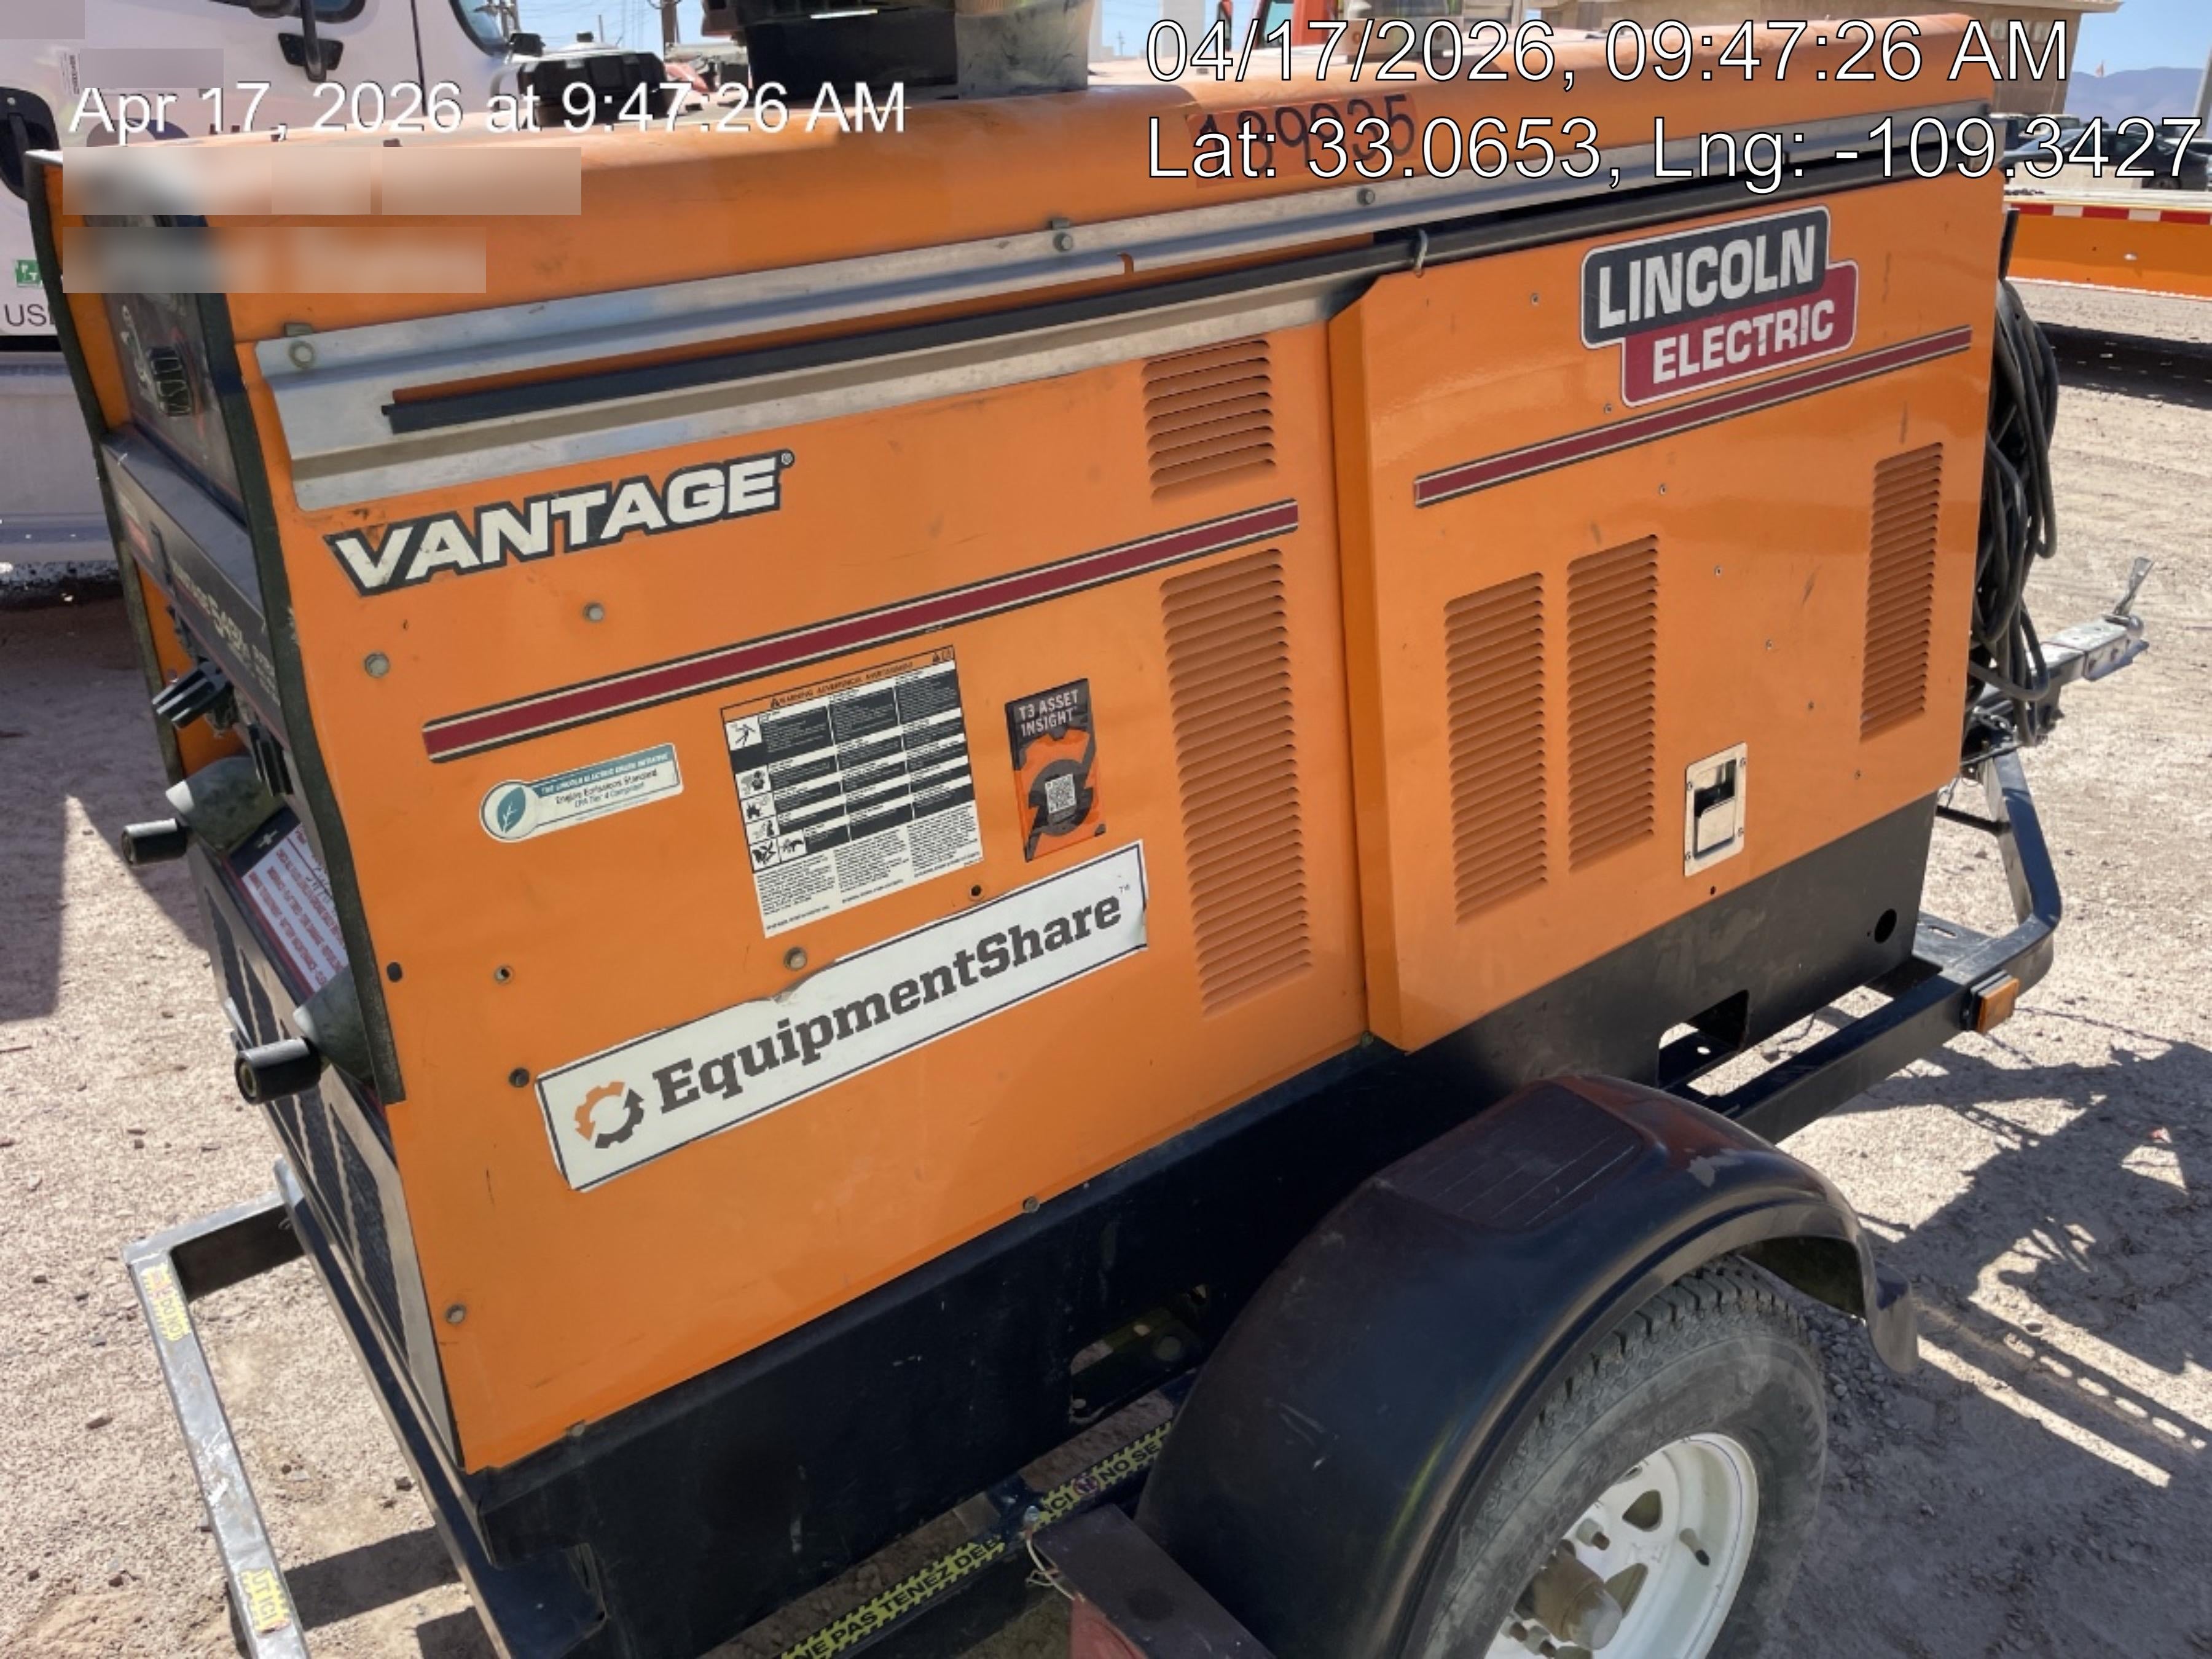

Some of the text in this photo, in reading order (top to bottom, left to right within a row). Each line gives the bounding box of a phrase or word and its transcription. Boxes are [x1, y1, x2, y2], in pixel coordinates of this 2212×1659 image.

[1599, 225, 1815, 329] LINCOLN
[4, 304, 55, 327] US
[1652, 299, 1835, 384] ELECTRIC
[1019, 688, 1079, 720] T3 ASSET
[1021, 707, 1074, 737] INSIGHT
[651, 894, 1123, 1115] EquipmentShare
[1097, 1459, 1130, 1483] NO
[830, 1610, 879, 1645] PAS
[878, 1563, 954, 1612] TENEZ
